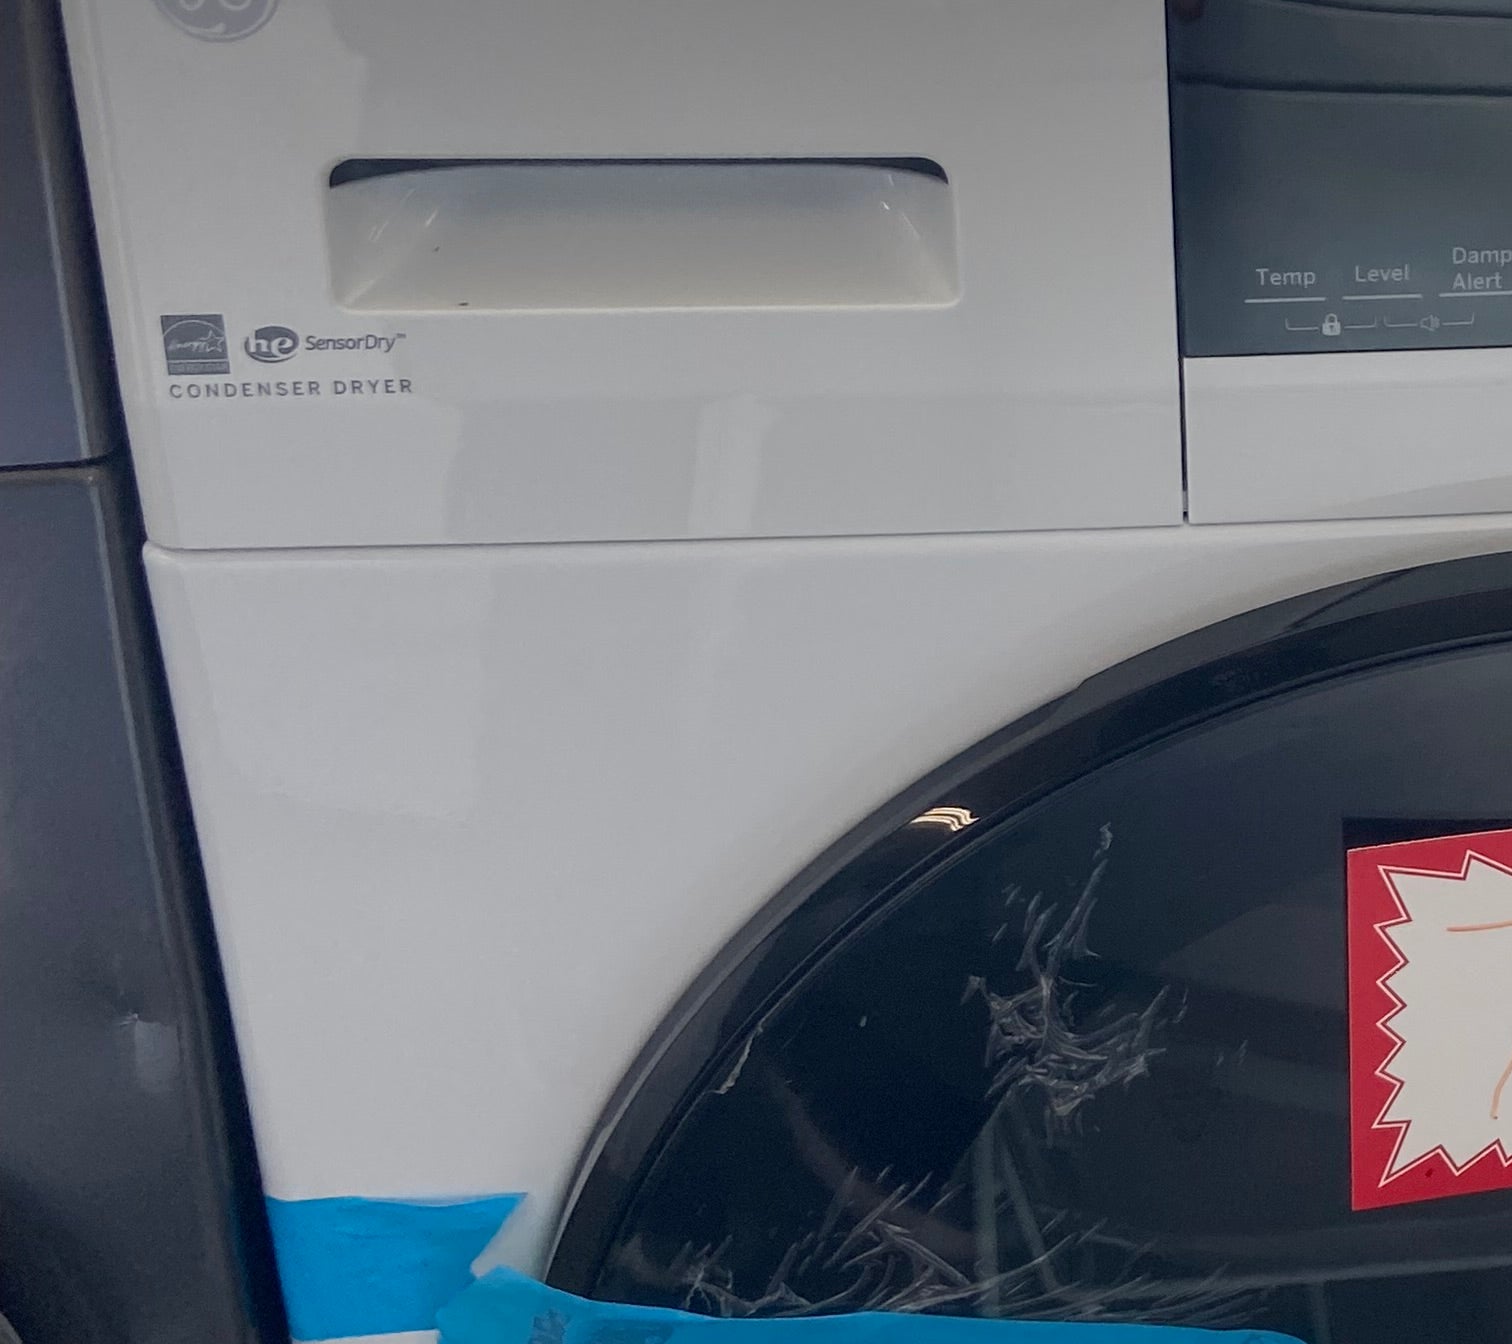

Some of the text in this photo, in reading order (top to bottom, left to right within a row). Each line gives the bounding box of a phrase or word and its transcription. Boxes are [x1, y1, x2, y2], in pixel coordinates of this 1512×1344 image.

[1451, 246, 1512, 267] Damp
[1255, 267, 1317, 289] Temp
[1354, 263, 1411, 284] Level
[1452, 271, 1503, 291] Alert
[169, 379, 413, 399] CONDENSER DRYER
